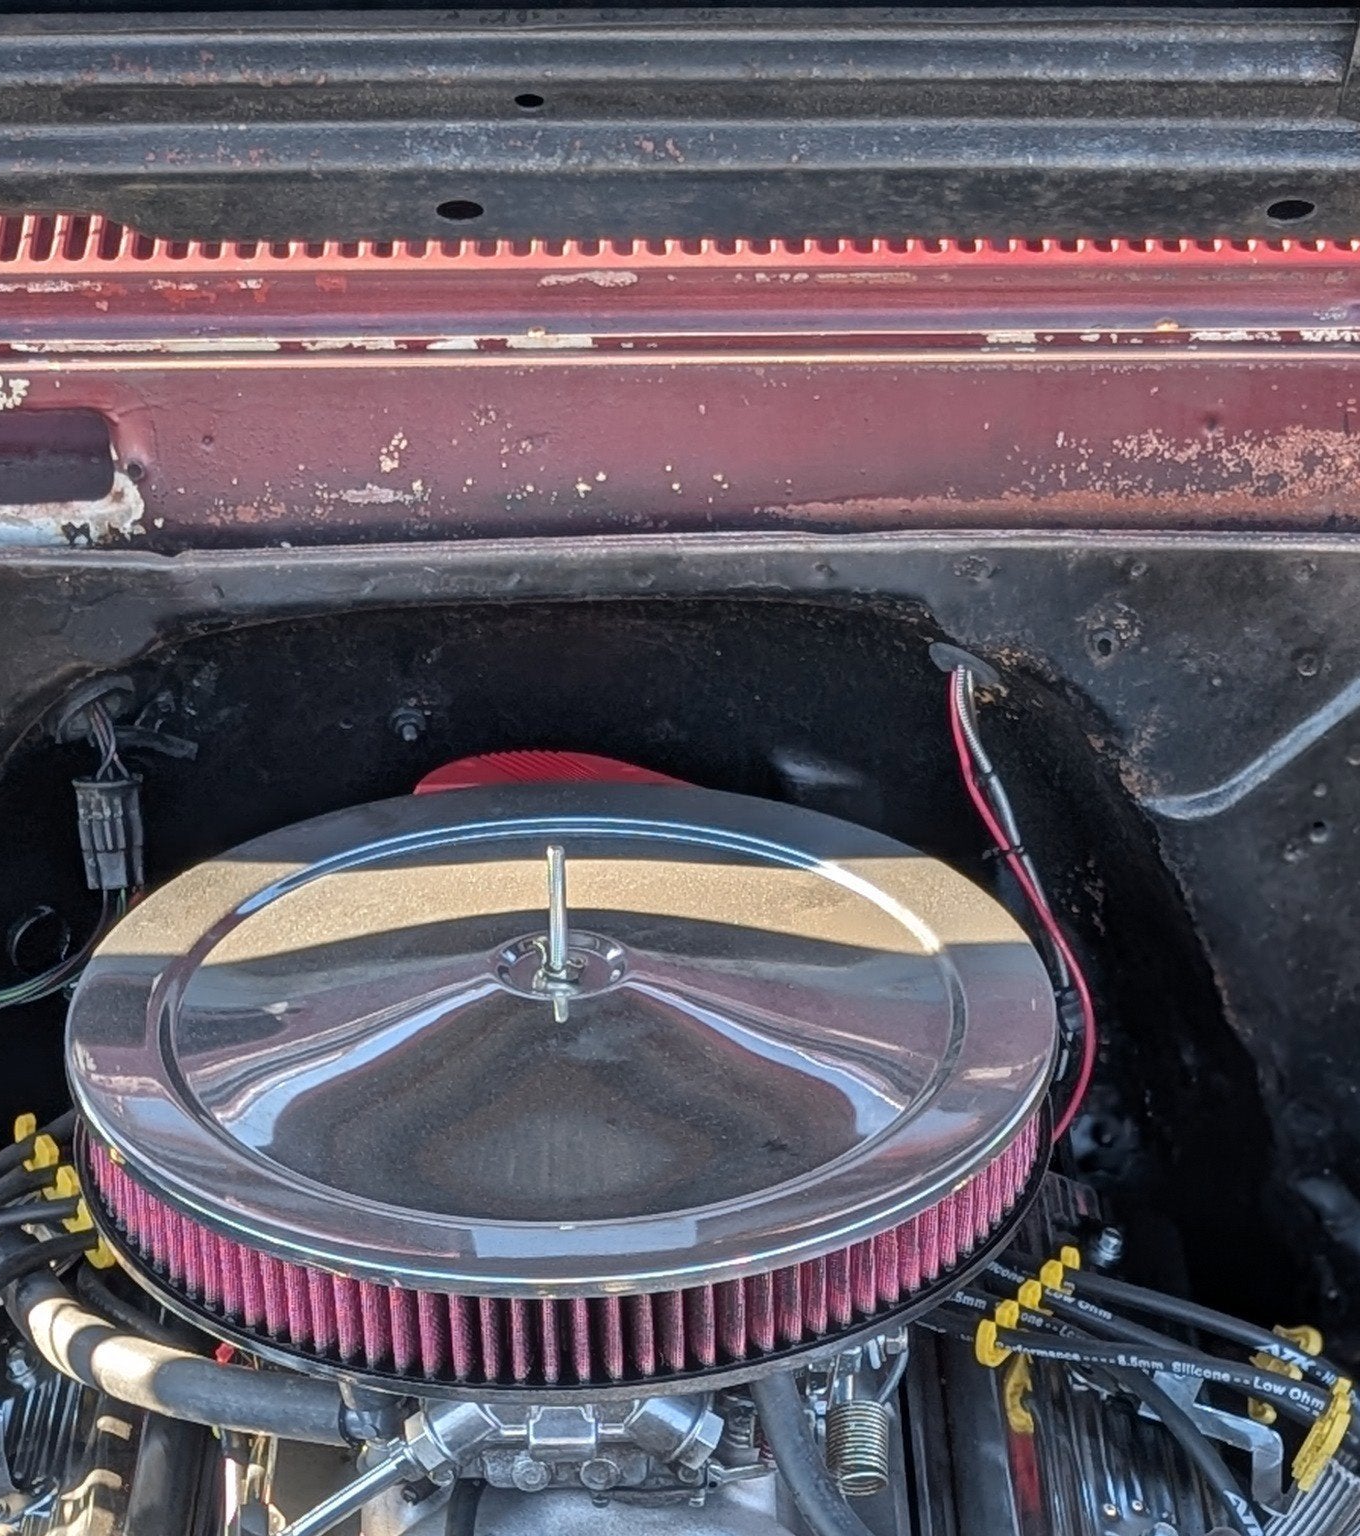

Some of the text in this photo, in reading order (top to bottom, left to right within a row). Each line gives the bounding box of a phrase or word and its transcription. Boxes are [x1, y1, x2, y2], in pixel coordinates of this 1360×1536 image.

[1253, 1343, 1317, 1372] ATK
[1116, 1353, 1165, 1371] 8.5mm
[1171, 1360, 1232, 1383] Silicone
[1252, 1375, 1288, 1396] Low
[1289, 1387, 1326, 1411] Ohm
